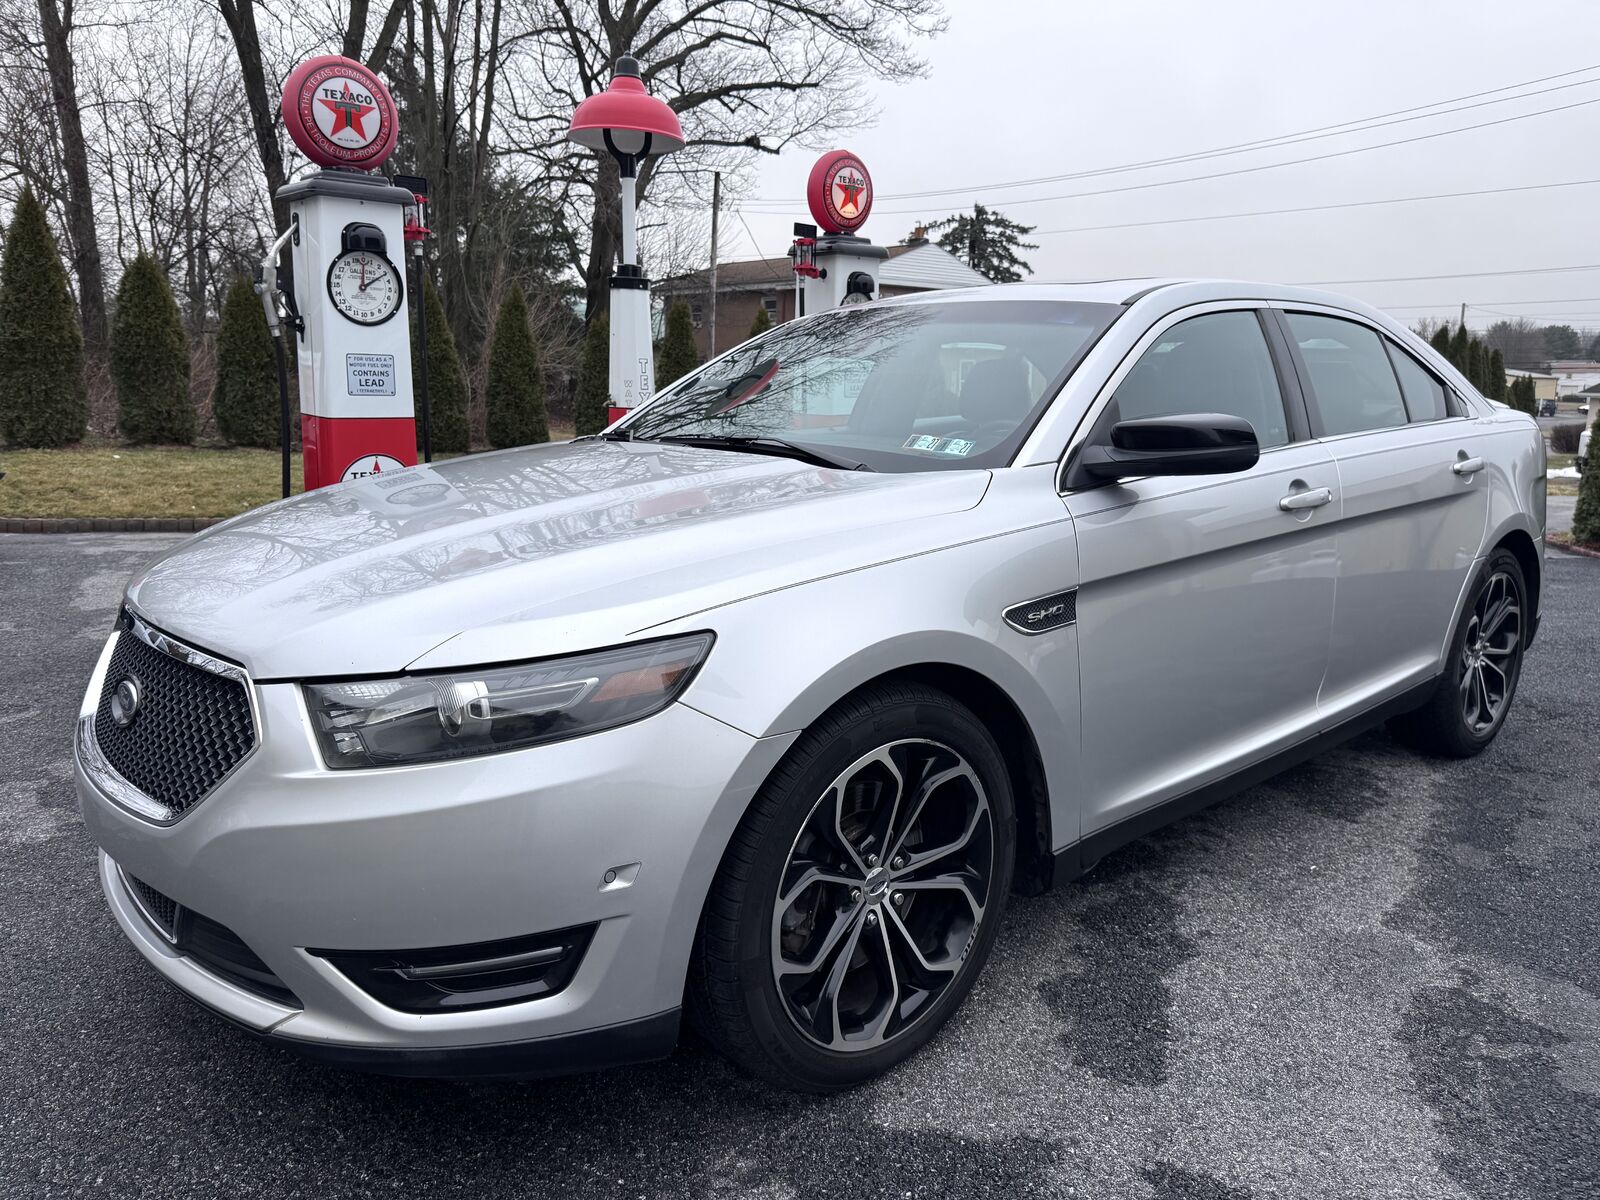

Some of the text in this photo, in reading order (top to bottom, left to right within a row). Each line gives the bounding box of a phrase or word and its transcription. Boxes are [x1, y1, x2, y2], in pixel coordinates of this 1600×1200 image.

[302, 90, 311, 108] THE
[307, 69, 332, 88] TEXAS
[335, 68, 377, 93] COMPANY
[322, 88, 372, 105] TEXACO
[305, 116, 388, 158] PETROLEUM PRODUCTS
[839, 176, 864, 186] TEXACO
[359, 379, 384, 387] LEAD
